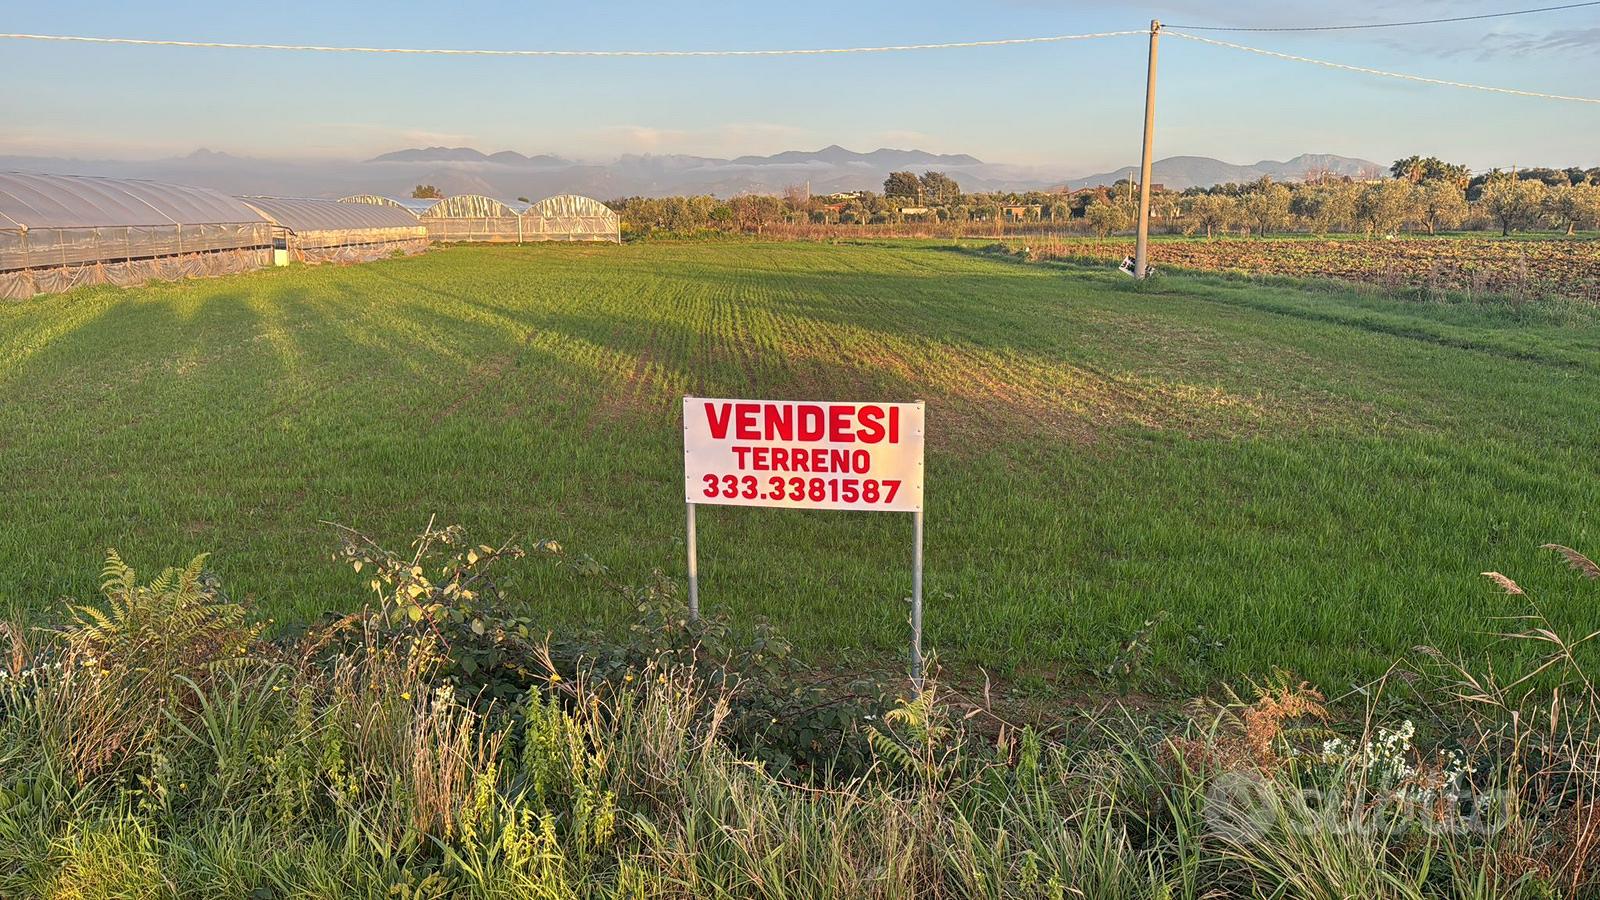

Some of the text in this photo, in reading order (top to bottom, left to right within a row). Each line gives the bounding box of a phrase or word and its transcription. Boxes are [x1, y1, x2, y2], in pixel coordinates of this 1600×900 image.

[704, 402, 900, 444] VENDESI
[731, 446, 870, 474] TERRENO
[702, 473, 902, 504] 333.3381587
